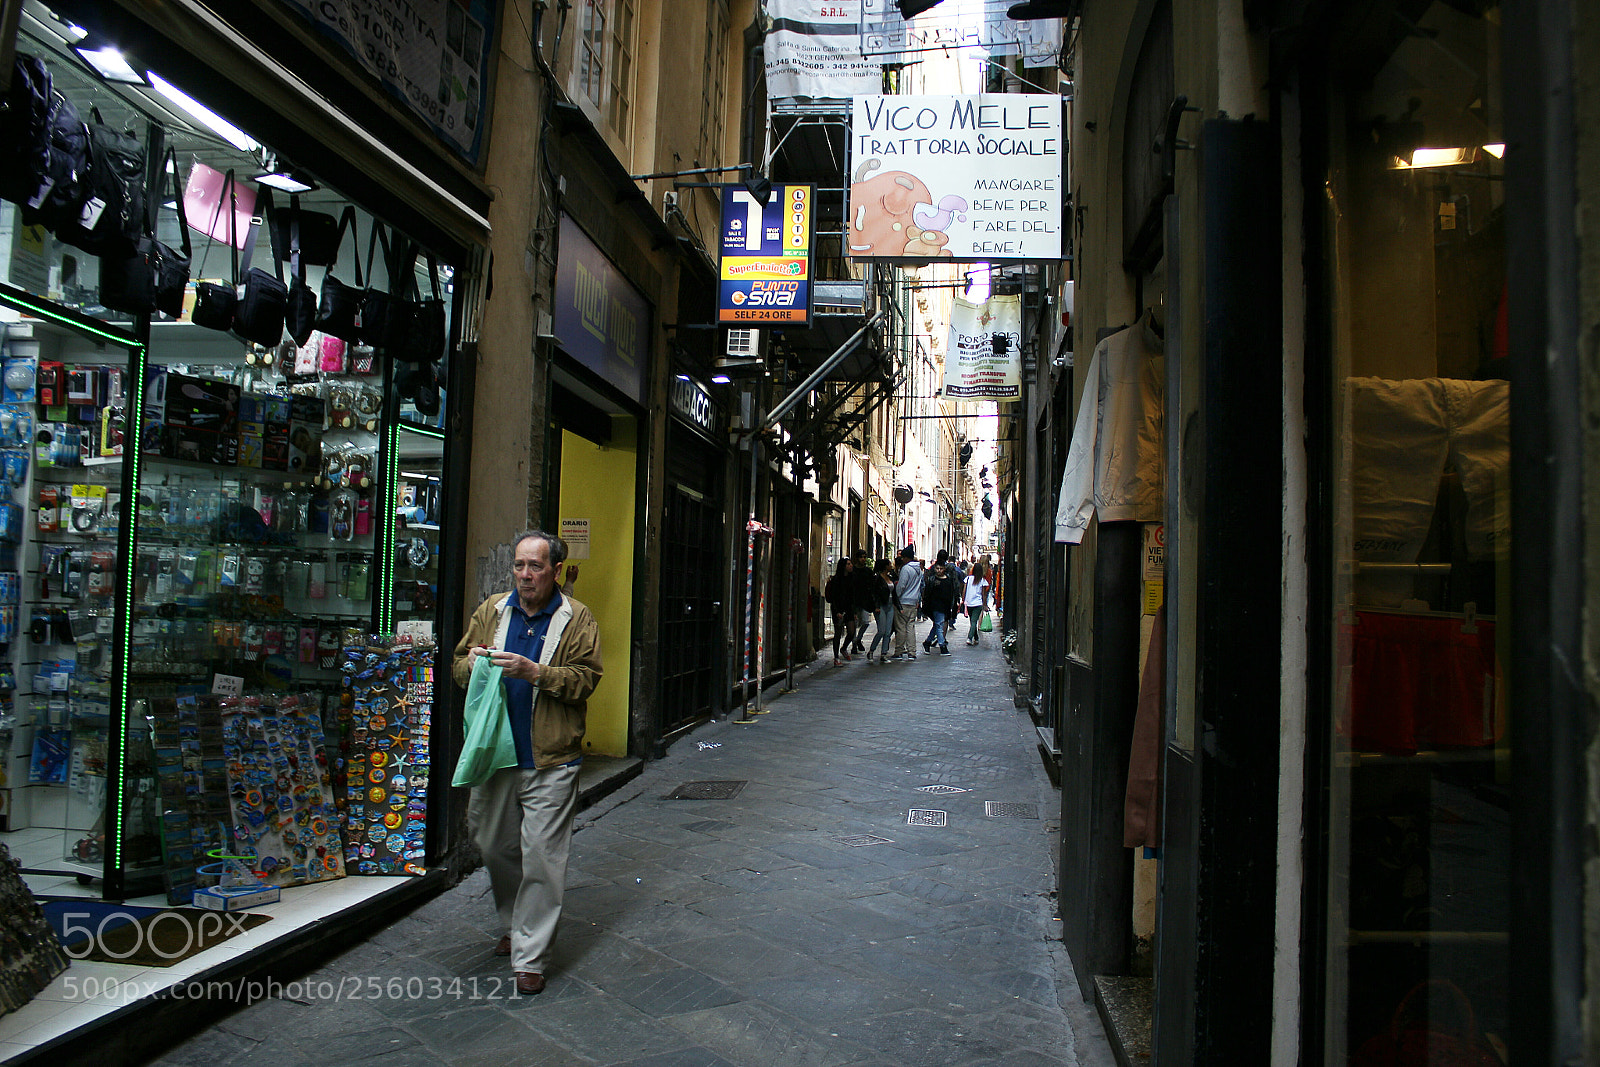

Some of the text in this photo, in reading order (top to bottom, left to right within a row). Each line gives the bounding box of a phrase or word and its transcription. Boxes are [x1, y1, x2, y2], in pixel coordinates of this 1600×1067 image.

[820, 7, 848, 17] S.R.L.
[865, 98, 1052, 131] VICO MELE
[859, 134, 1057, 156] TRATTORIA SOCIALE
[973, 178, 1055, 191] MANGIARE
[973, 198, 1050, 212] BENE PER
[972, 220, 1056, 233] FARE DEL
[751, 280, 800, 291] PUNTO
[735, 310, 792, 319] SELF 24 ORE
